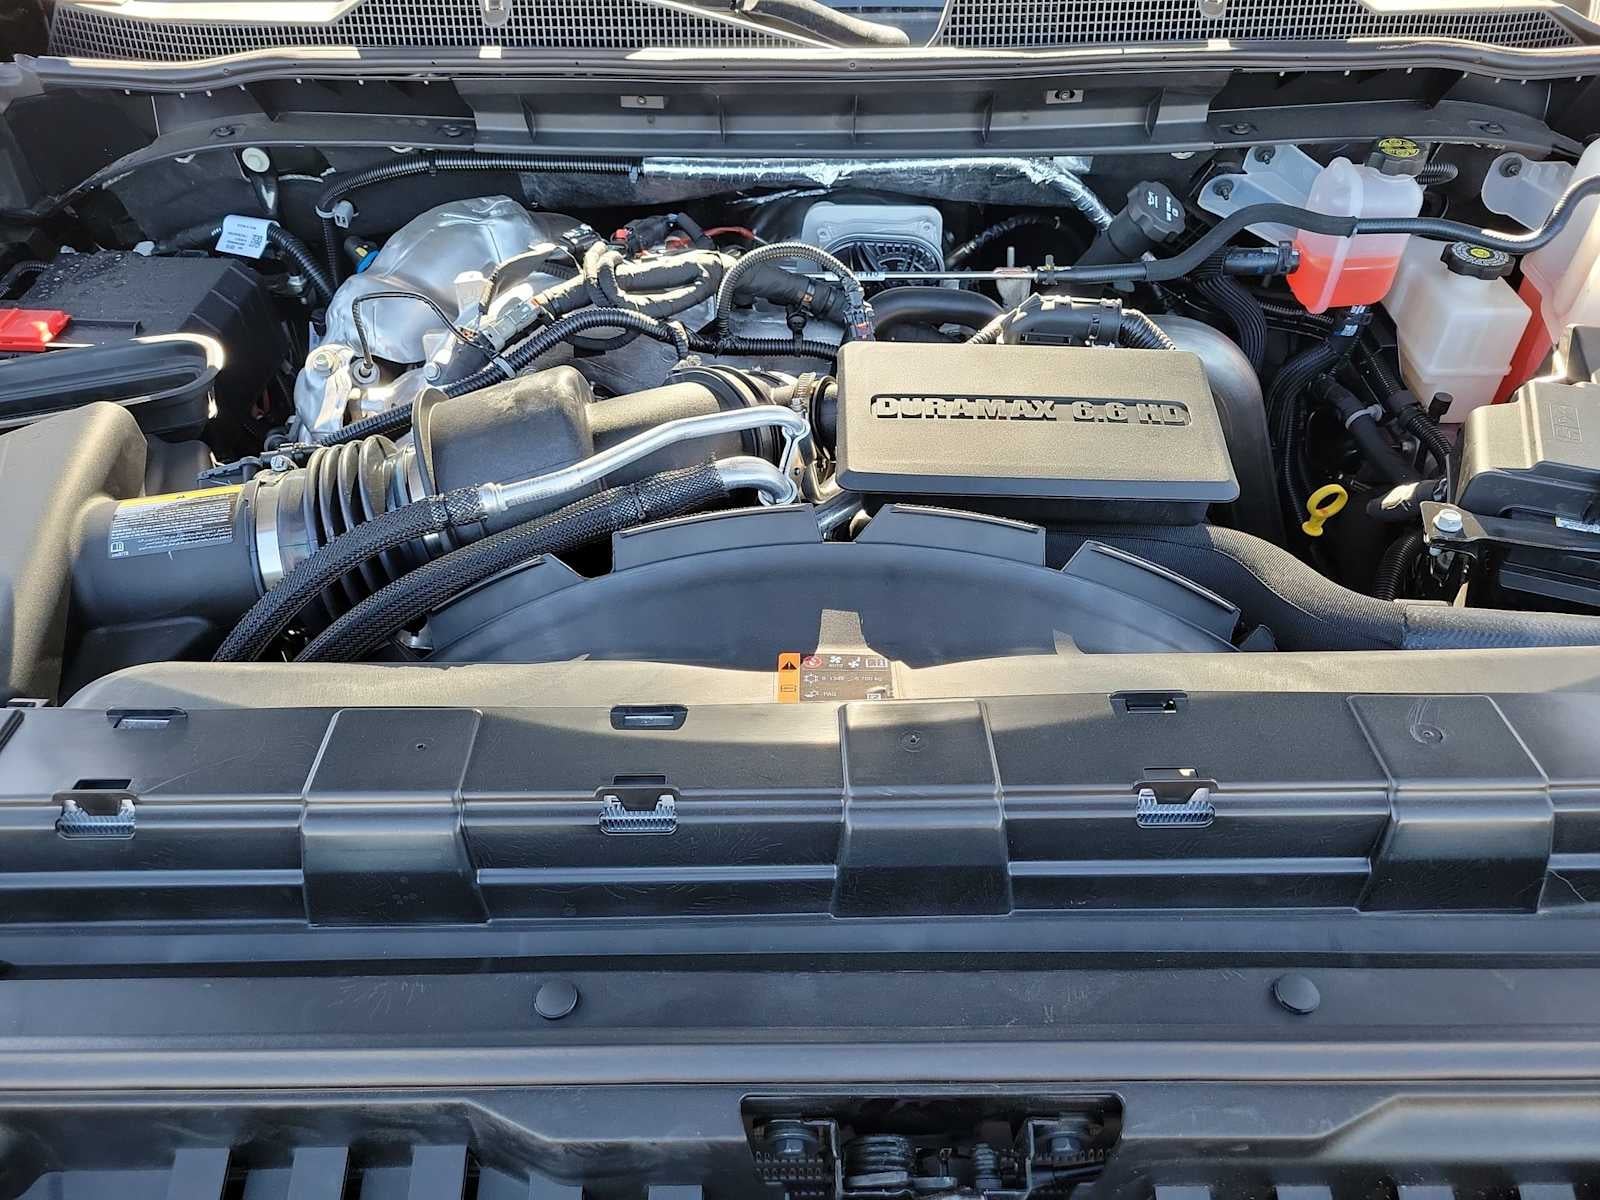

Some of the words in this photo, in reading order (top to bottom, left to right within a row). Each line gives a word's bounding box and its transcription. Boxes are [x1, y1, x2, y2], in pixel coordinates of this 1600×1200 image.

[871, 397, 1057, 421] DURAMAX
[1071, 400, 1129, 423] 6.6
[1135, 403, 1188, 426] HD
